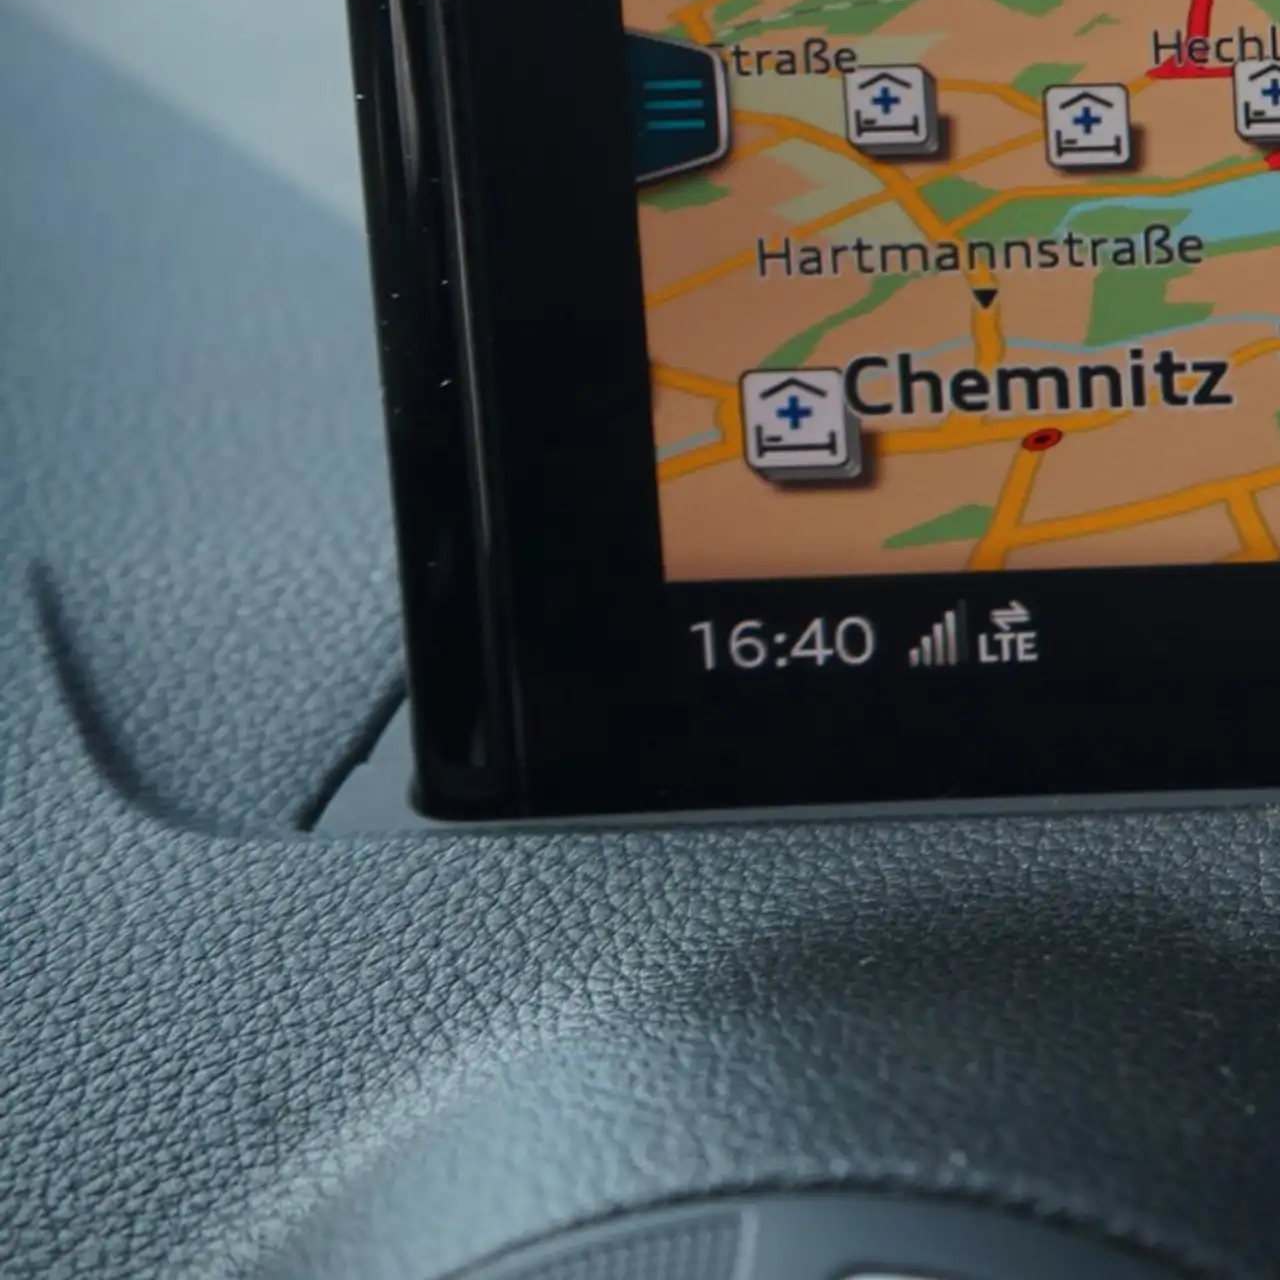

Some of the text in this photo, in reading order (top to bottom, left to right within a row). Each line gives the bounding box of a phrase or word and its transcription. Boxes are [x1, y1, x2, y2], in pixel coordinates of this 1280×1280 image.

[705, 37, 857, 77] traße
[757, 225, 1204, 277] Hartmannstraße
[845, 347, 1234, 417] Chemnitz
[690, 616, 875, 671] 16:40
[978, 630, 1038, 664] LTE
